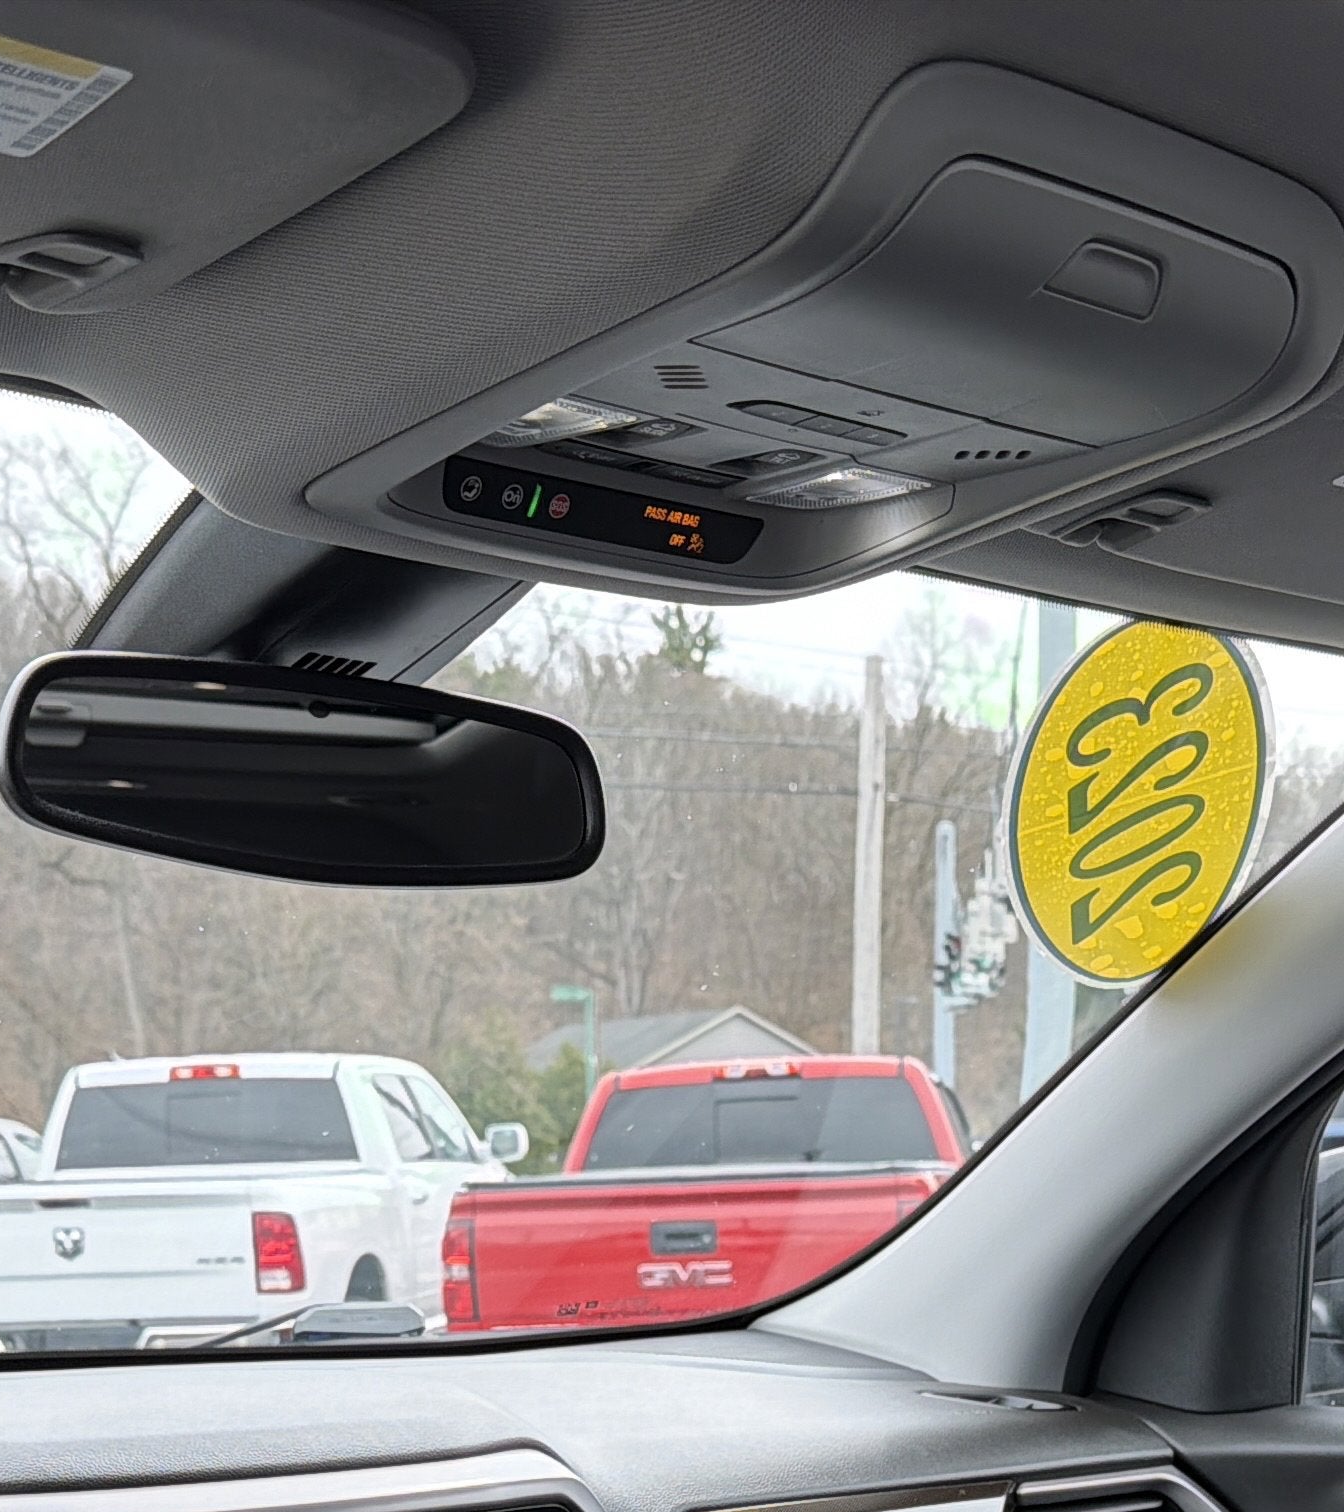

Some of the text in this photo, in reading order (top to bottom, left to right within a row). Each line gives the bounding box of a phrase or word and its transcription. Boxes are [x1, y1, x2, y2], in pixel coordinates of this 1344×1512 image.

[644, 505, 701, 528] PASS AIR BAG
[668, 533, 687, 547] OFF
[636, 1259, 734, 1290] GMC
